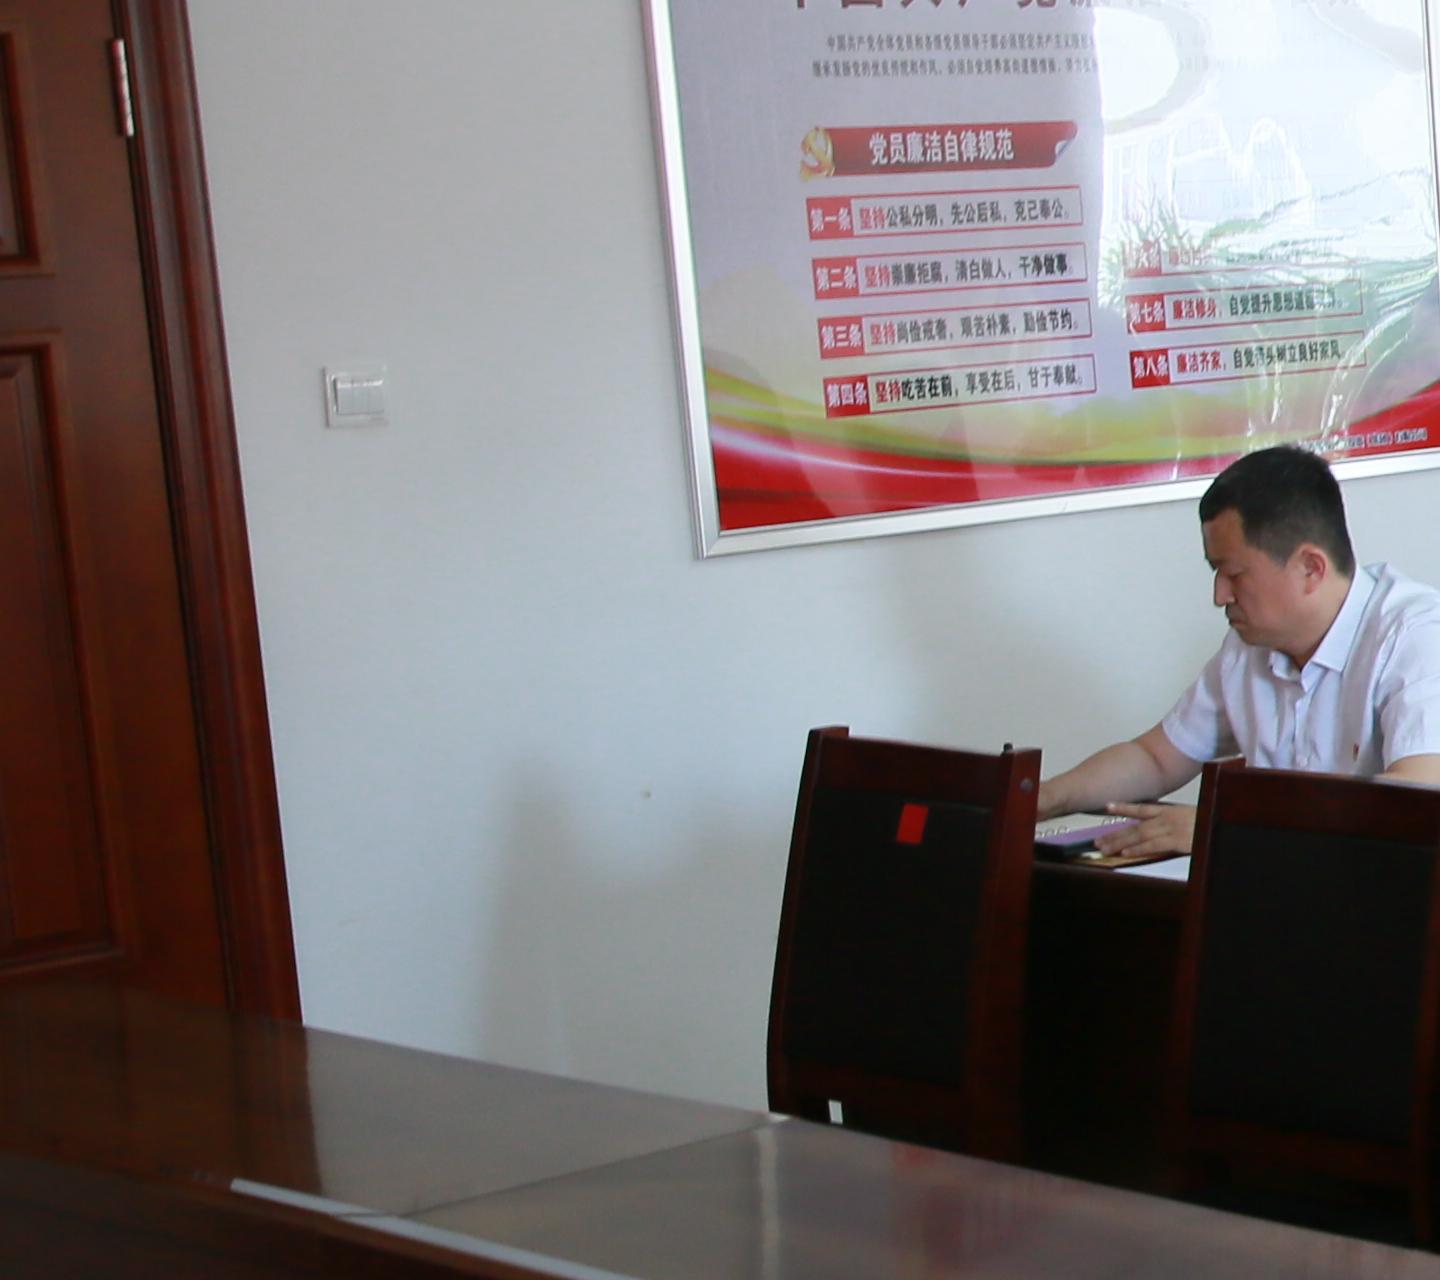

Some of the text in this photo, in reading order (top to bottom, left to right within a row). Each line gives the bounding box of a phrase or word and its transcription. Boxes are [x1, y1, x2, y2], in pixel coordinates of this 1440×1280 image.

[869, 128, 1014, 166] 党员廉洁自律规范
[810, 206, 851, 233] 第一条
[815, 265, 859, 292] 第二条
[1129, 298, 1166, 326] 第七条
[820, 322, 863, 349] 第三条
[1132, 352, 1169, 379] 第八条
[826, 380, 868, 409] 第四条
